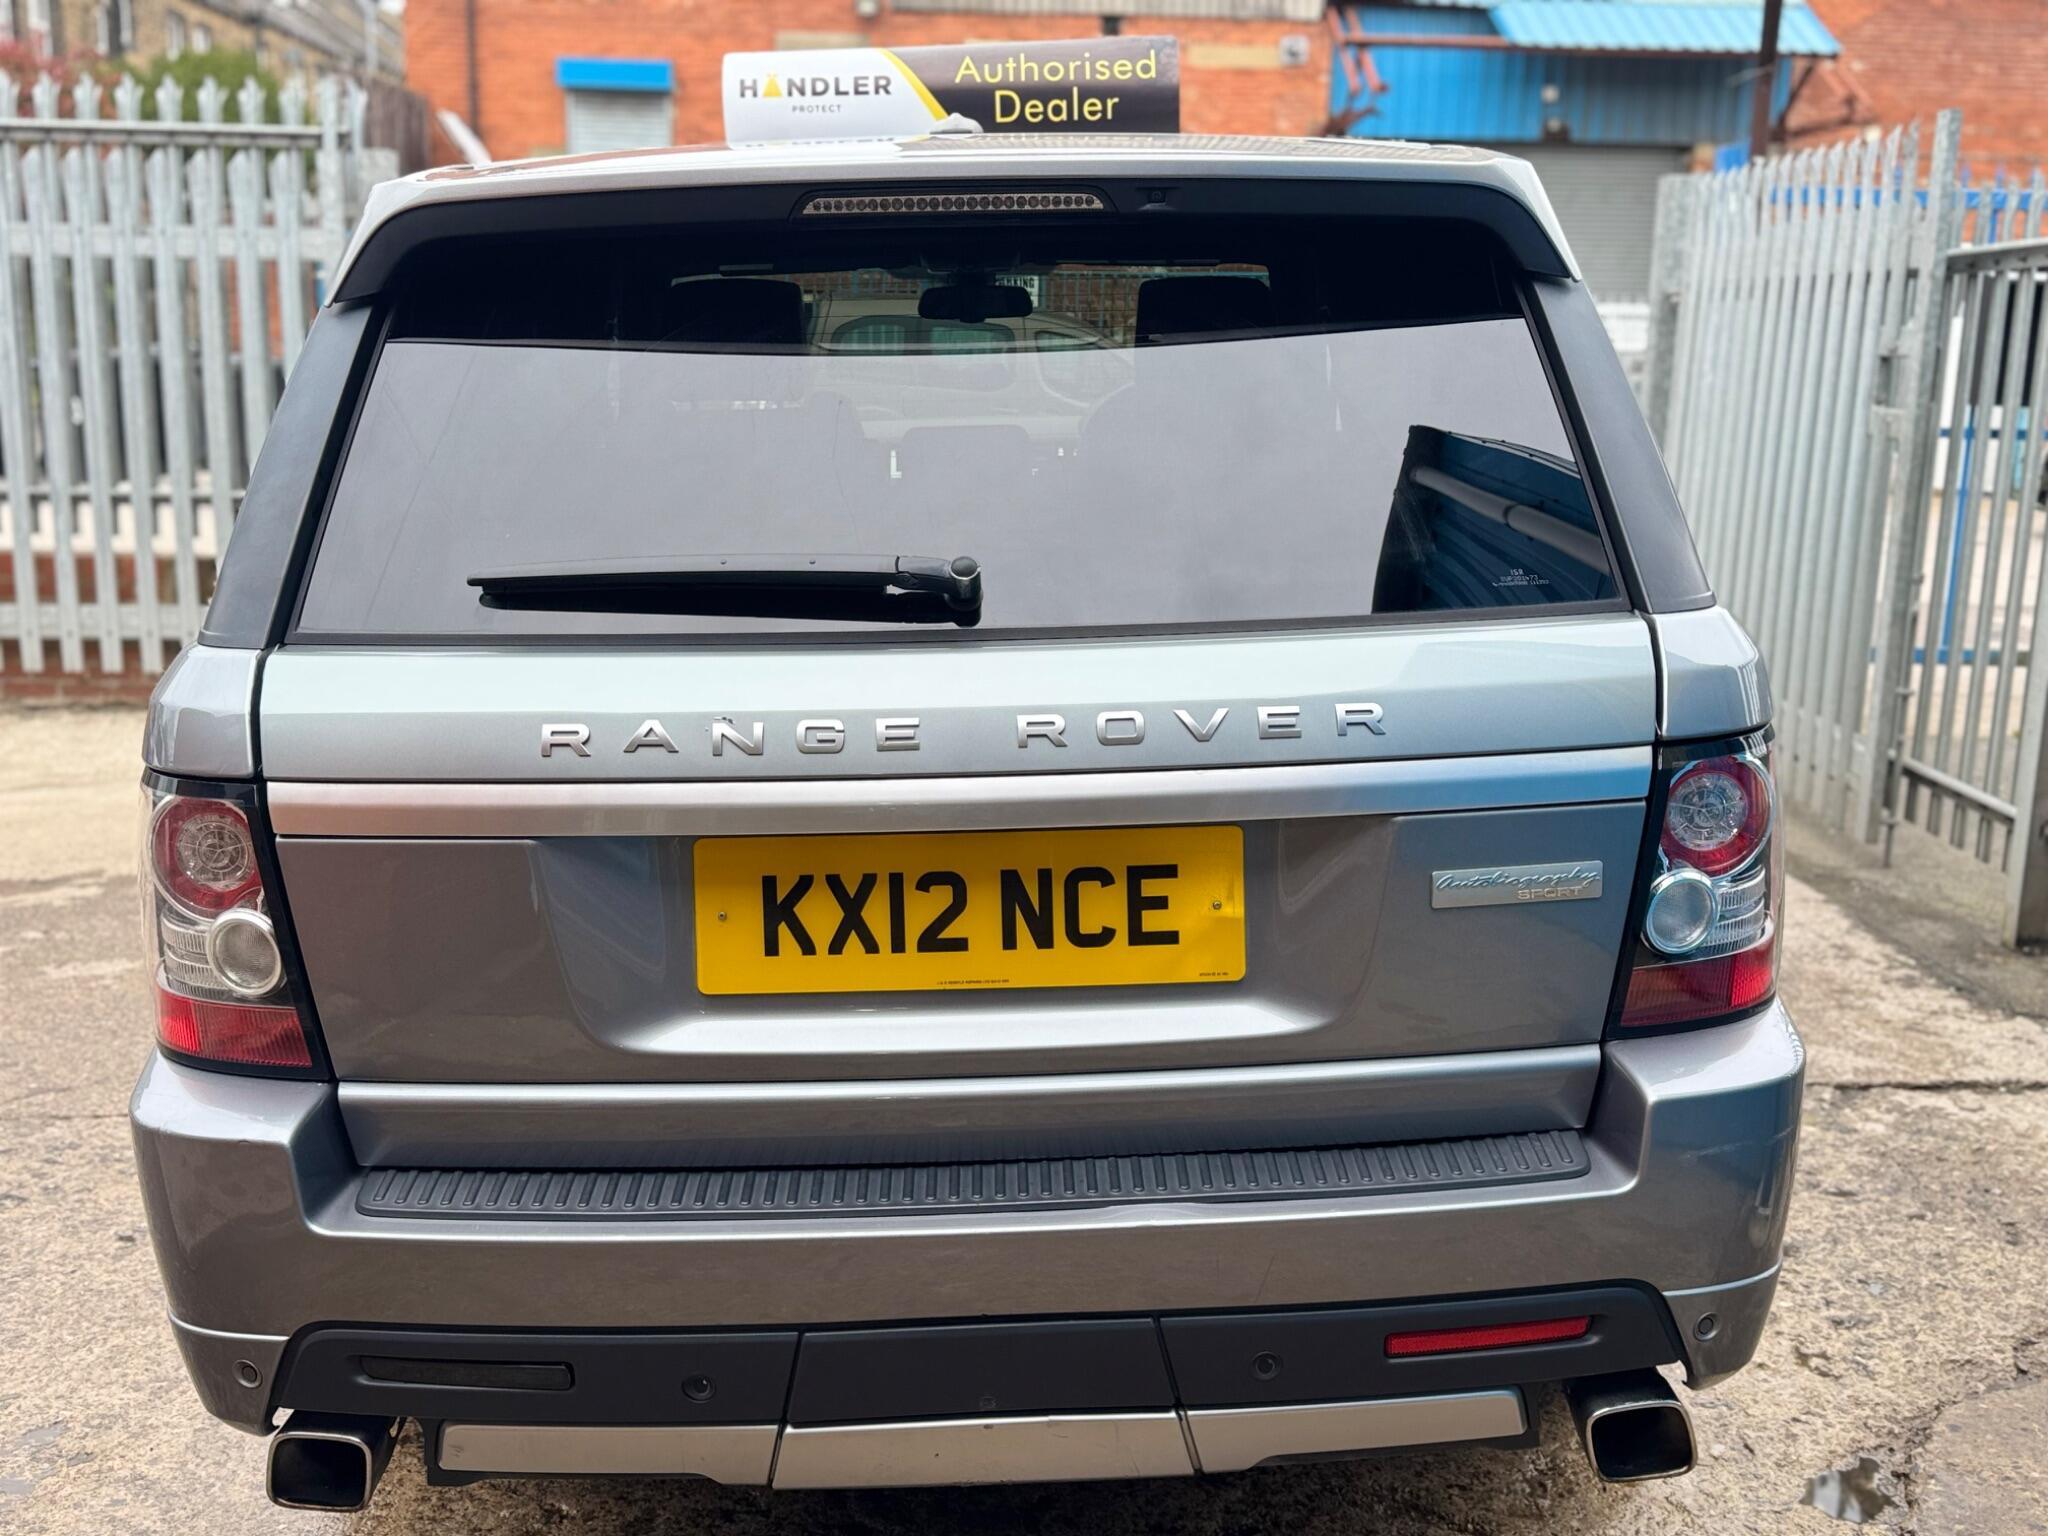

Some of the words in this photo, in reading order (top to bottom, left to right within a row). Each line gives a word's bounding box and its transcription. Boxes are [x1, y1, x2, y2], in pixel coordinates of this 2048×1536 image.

[954, 50, 1157, 84] Authorised
[791, 104, 843, 113] PROTECT
[994, 89, 1120, 124] Dealer
[541, 717, 921, 757] RANGE
[1016, 702, 1387, 748] ROVER
[761, 870, 969, 957] KX12
[1000, 863, 1180, 951] NCE
[1517, 886, 1583, 900] SPORT
